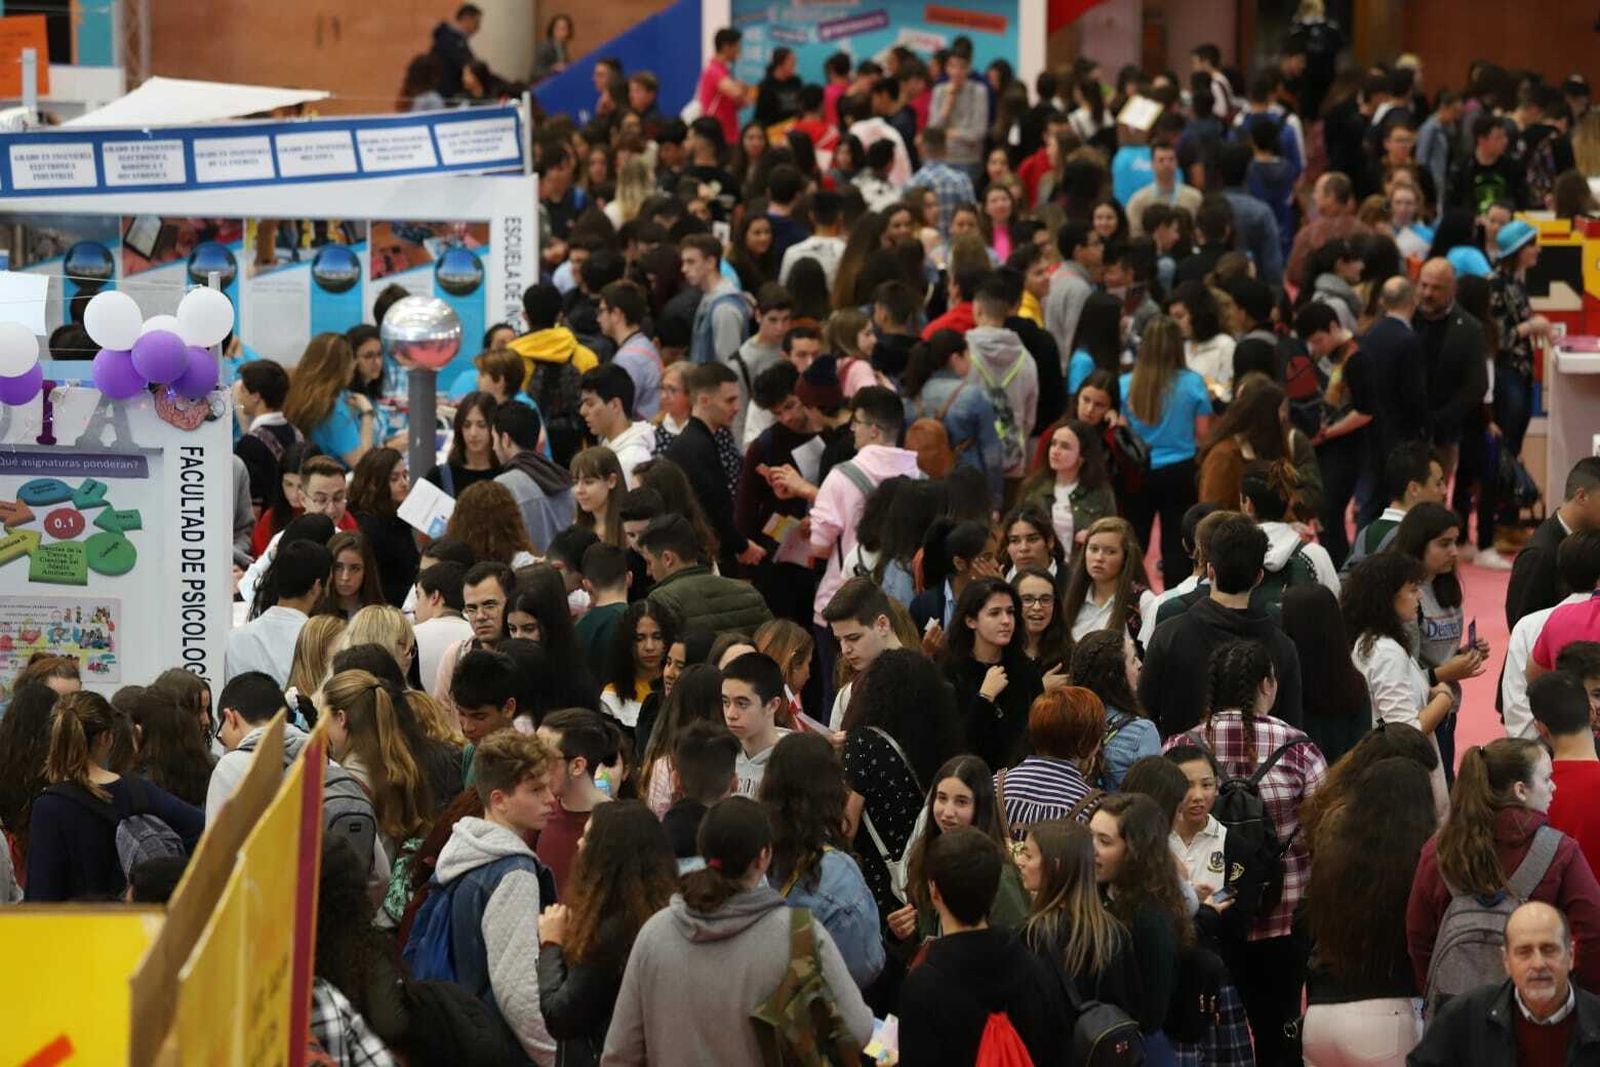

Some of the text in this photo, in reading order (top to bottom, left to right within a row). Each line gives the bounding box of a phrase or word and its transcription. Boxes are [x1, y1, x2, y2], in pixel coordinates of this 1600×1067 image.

[504, 217, 522, 278] ESCUELA
[504, 283, 522, 300] DE
[21, 457, 81, 469] asignaturas
[83, 459, 139, 470] ponderan?
[54, 517, 75, 529] 0.1
[180, 446, 211, 681] FACULTAD DE PSICOLOG
